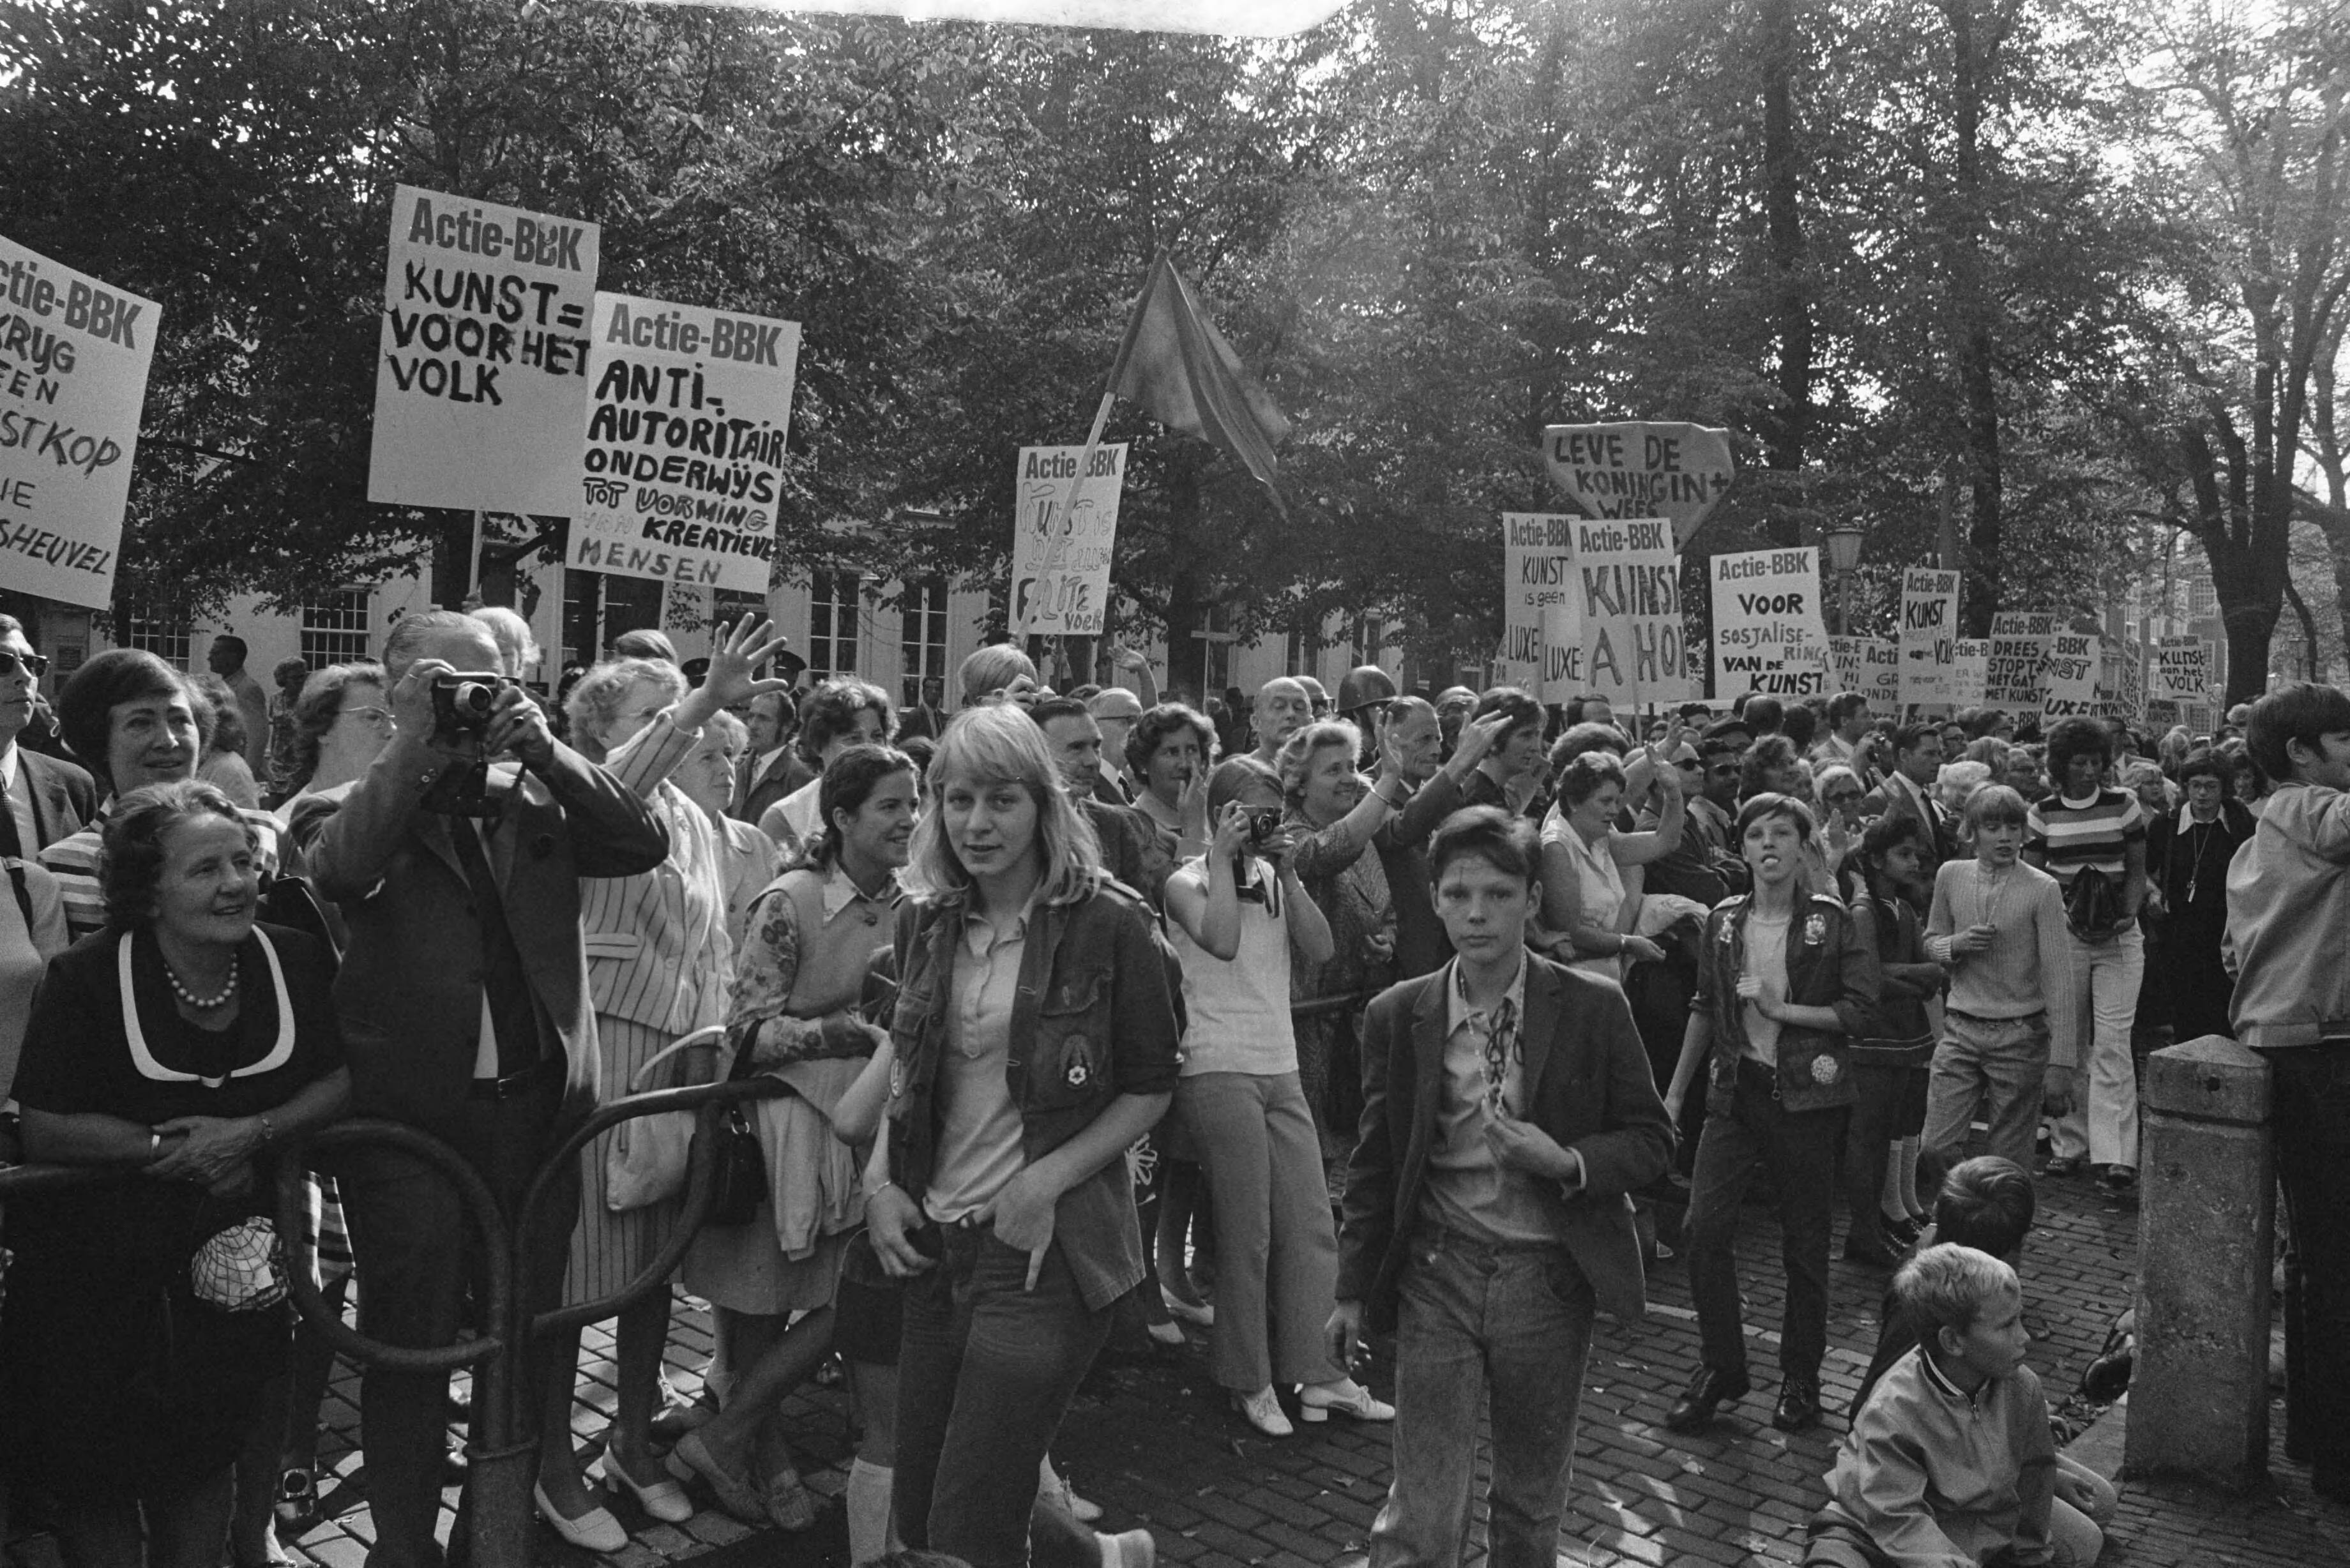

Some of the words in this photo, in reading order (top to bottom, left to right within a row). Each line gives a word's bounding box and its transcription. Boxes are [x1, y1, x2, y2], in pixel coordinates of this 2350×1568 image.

[408, 197, 584, 272] Actie-BBK
[384, 304, 516, 364] VOOR
[520, 327, 591, 377] HET
[606, 303, 782, 367] Actie-BBK
[384, 351, 503, 405] VOLK
[1554, 433, 1624, 468] LEVE
[1644, 434, 1681, 472] DE
[1575, 469, 1708, 504] KONINGIN
[1579, 523, 1665, 553] Actie-BBK
[577, 538, 722, 585] MENSEN
[1522, 555, 1569, 585] KUNST
[1718, 552, 1810, 582] Actie-BBK
[1905, 572, 1956, 594] Actie-BBK
[1536, 591, 1566, 607] geen
[1737, 592, 1804, 615] VOOR
[1905, 598, 1948, 631] KUNST
[1992, 615, 2054, 635] Actie-BBK
[1994, 640, 2040, 658] DREES
[1722, 656, 1762, 674] VAN
[1766, 660, 1785, 671] DE
[1988, 657, 2038, 677] STOPT
[2160, 667, 2180, 675] aan
[2183, 666, 2203, 677] het
[1749, 672, 1824, 695] KUNST
[1987, 674, 2011, 686] HET
[2012, 674, 2037, 688] GAT
[2164, 675, 2206, 693] VOLK
[1985, 688, 2006, 700] MET
[2008, 688, 2046, 704] KUNST
